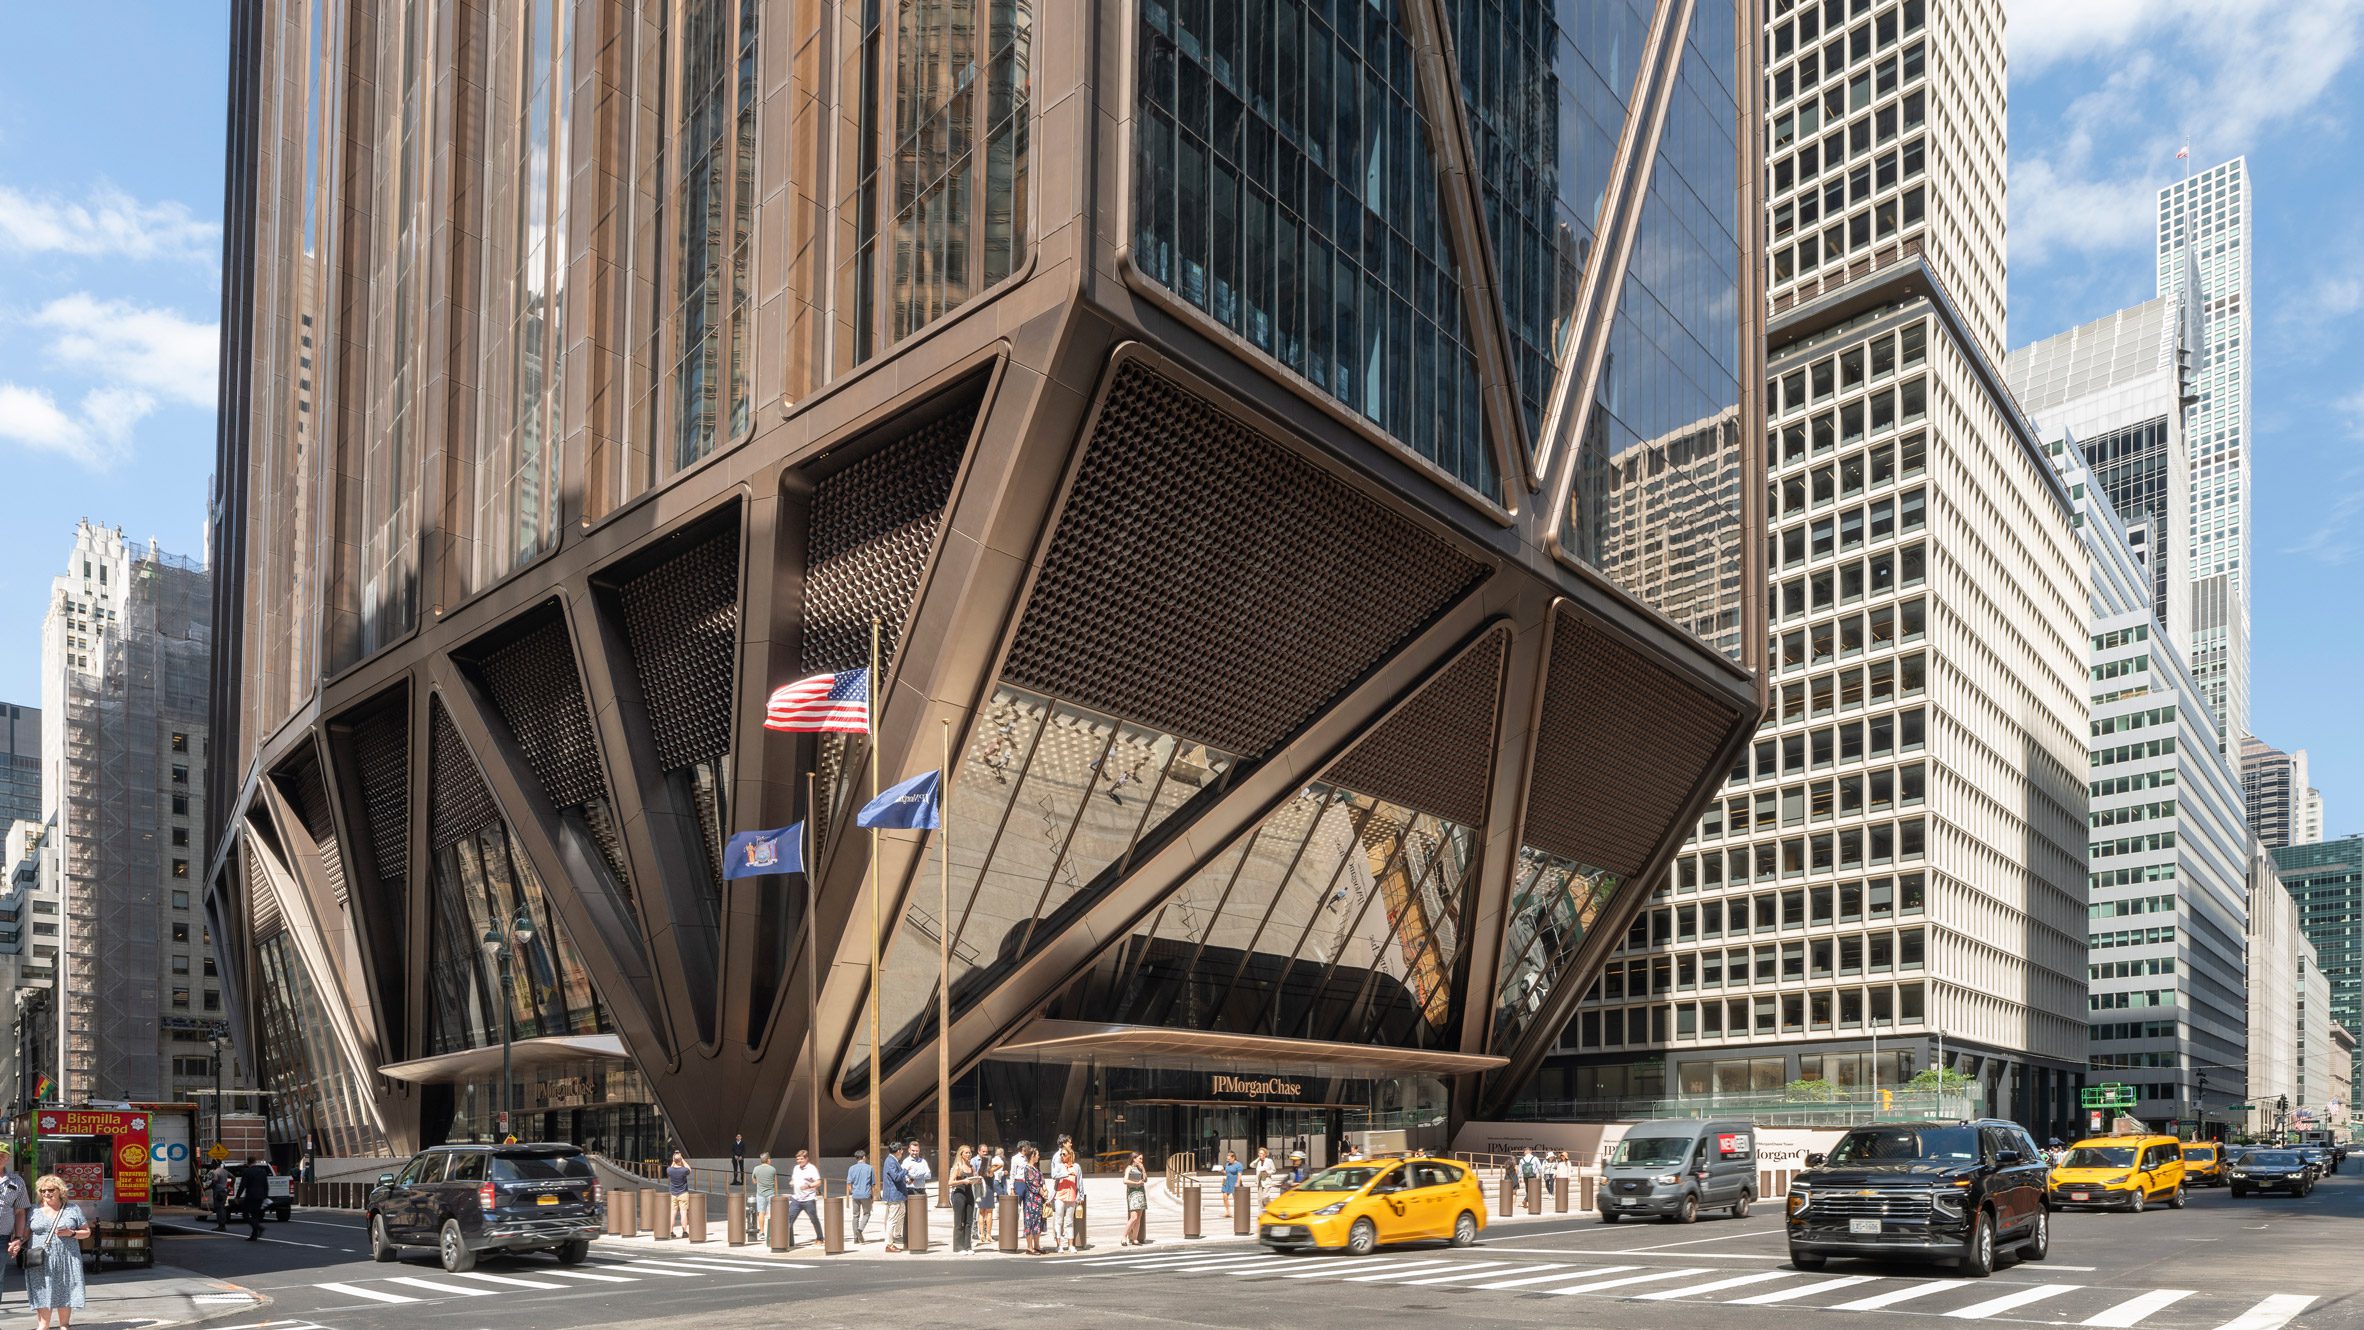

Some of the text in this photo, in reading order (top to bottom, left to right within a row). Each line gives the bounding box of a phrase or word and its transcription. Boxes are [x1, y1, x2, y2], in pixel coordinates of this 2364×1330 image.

[1212, 1076, 1301, 1097] JPMorganChase
[67, 1113, 121, 1124] Bismilla
[59, 1124, 128, 1134] Halal Food
[151, 1143, 188, 1161] CO
